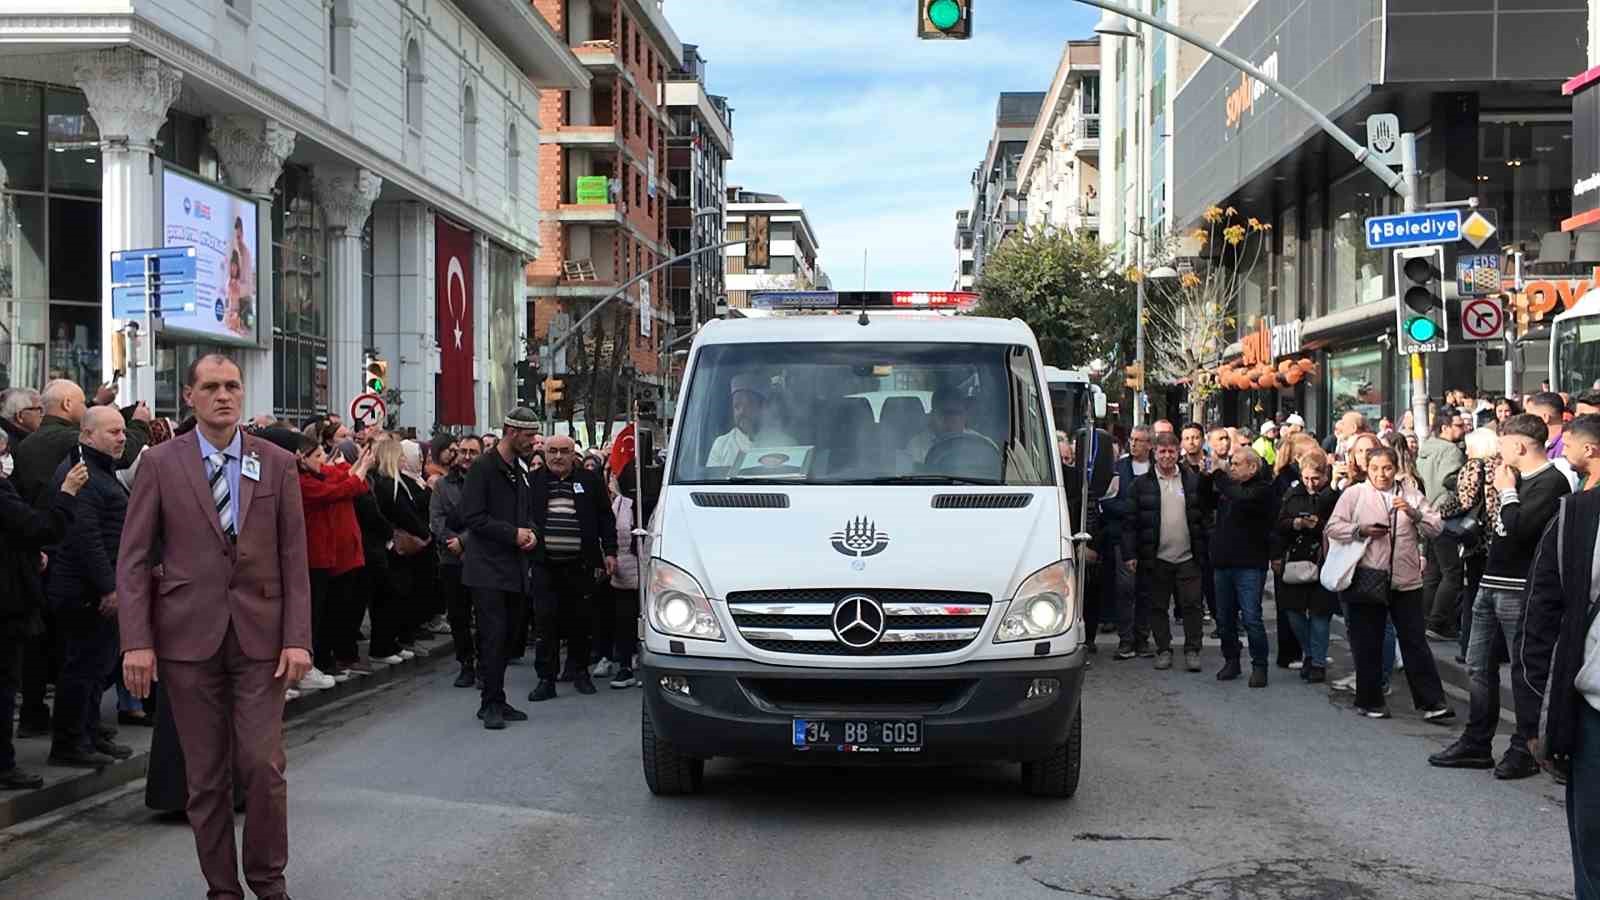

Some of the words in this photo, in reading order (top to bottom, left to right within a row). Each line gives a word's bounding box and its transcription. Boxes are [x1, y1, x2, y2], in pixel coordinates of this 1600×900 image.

[1383, 217, 1457, 238] Belediye
[1473, 255, 1498, 268] EDS
[807, 721, 831, 742] 34
[844, 721, 869, 743] BB
[881, 721, 918, 743] 609
